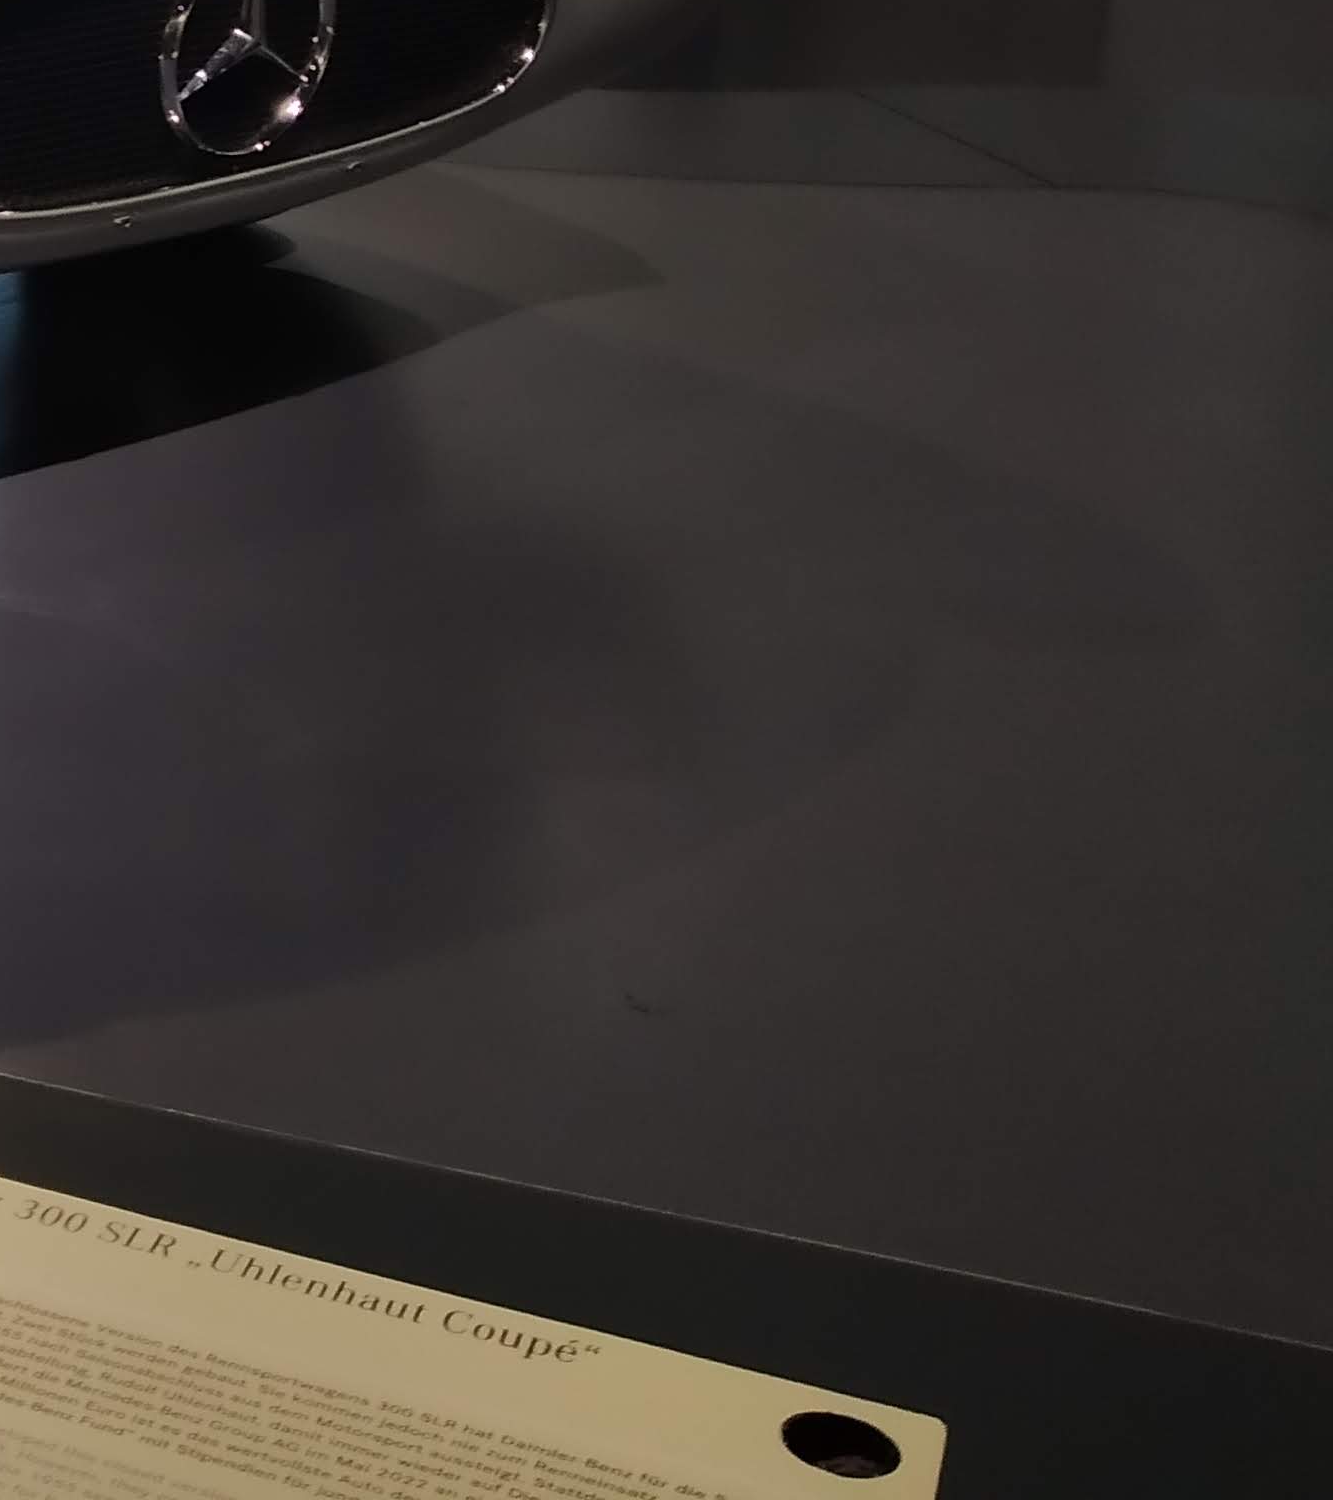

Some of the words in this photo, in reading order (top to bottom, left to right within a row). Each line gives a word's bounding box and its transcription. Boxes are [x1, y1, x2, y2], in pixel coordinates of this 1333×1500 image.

[15, 1201, 87, 1232] 300
[98, 1223, 176, 1257] SLR
[189, 1250, 424, 1323] „Uhlenhaut
[443, 1312, 599, 1362] Coupé“
[0, 1376, 78, 1405] Millionen
[85, 1401, 125, 1419] Euro
[132, 1415, 154, 1428] ist
[160, 1425, 180, 1435] es
[187, 1432, 218, 1446] das
[226, 1444, 331, 1478] wertvollste
[338, 1476, 383, 1494] Auto
[12, 1315, 52, 1332] Zwei
[58, 1329, 106, 1348] Stück
[113, 1347, 177, 1366] werden
[259, 1385, 285, 1398] Sie
[293, 1394, 373, 1423] kommen
[378, 1419, 444, 1442] jedoch
[451, 1440, 479, 1452] nie
[486, 1450, 527, 1465] zum
[27, 1337, 69, 1353] nach
[230, 1395, 261, 1408] aus
[269, 1406, 309, 1420] dem
[317, 1417, 423, 1453] Motorsport
[33, 1371, 59, 1382] die
[209, 1421, 265, 1443] Group
[272, 1439, 299, 1452] AG
[305, 1447, 328, 1460] im
[336, 1456, 371, 1472] Mai
[377, 1468, 427, 1488] 2022
[98, 1324, 162, 1348] Version
[168, 1345, 197, 1359] des
[206, 1353, 369, 1405] Rennsportwagens
[380, 1401, 413, 1417] 300
[421, 1413, 457, 1428] SLR
[463, 1425, 493, 1439] hat
[640, 1473, 669, 1487] für
[100, 1372, 157, 1394] Rudolf
[269, 1422, 322, 1441] damit
[329, 1438, 389, 1460] immer
[399, 1460, 461, 1480] wieder
[471, 1480, 502, 1492] auf
[139, 1436, 170, 1449] mit
[177, 1444, 277, 1480] Stipendien
[283, 1476, 310, 1489] für
